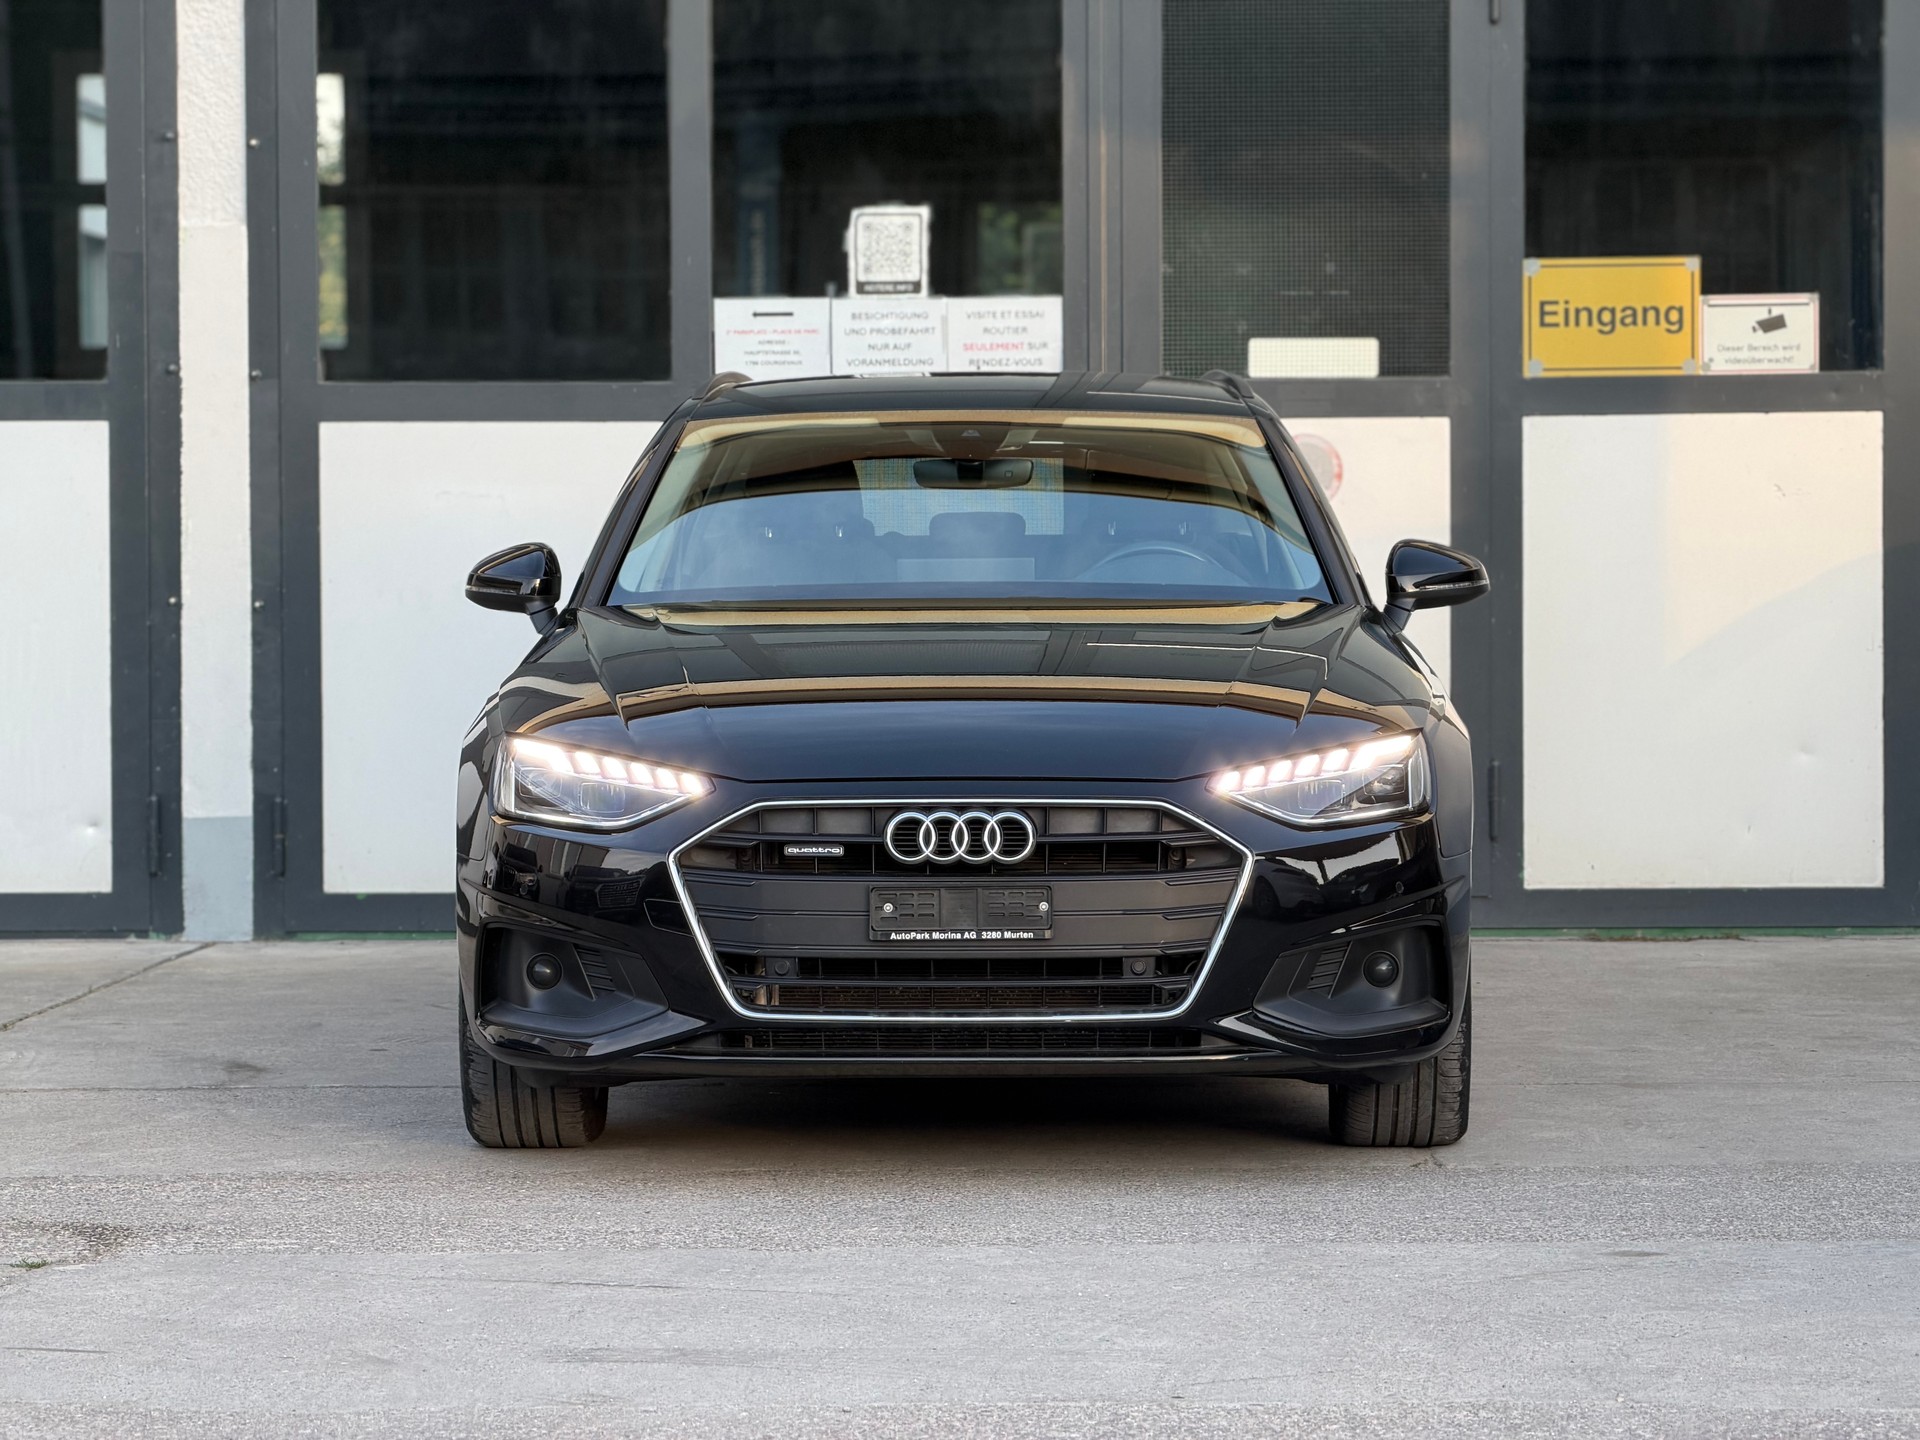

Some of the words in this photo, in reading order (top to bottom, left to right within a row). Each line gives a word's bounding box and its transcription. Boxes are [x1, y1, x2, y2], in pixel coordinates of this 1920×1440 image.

[851, 311, 929, 320] BESICHTIGUNG
[966, 310, 997, 319] VISITE
[1000, 310, 1012, 319] ET
[1015, 310, 1044, 319] ESSAI
[1539, 300, 1684, 335] Eingang
[844, 327, 867, 336] UND
[870, 327, 936, 336] PROBEFAHRT
[983, 326, 1028, 335] ROUTIER
[868, 342, 890, 351] NUR
[892, 342, 912, 351] AUF
[963, 342, 1024, 351] SEULEMENT
[1027, 342, 1048, 350] SUR
[1717, 344, 1745, 352] Dieser
[1747, 343, 1779, 352] Bereich
[1782, 343, 1801, 351] wird
[846, 358, 934, 367] VORANMELDUNG
[969, 358, 1043, 367] RENDEZ-VOUS
[890, 931, 930, 940] AutoPark
[932, 931, 962, 940] Morina
[963, 931, 977, 939] AG
[981, 931, 1002, 939] 3280
[1003, 931, 1034, 939] Murten
